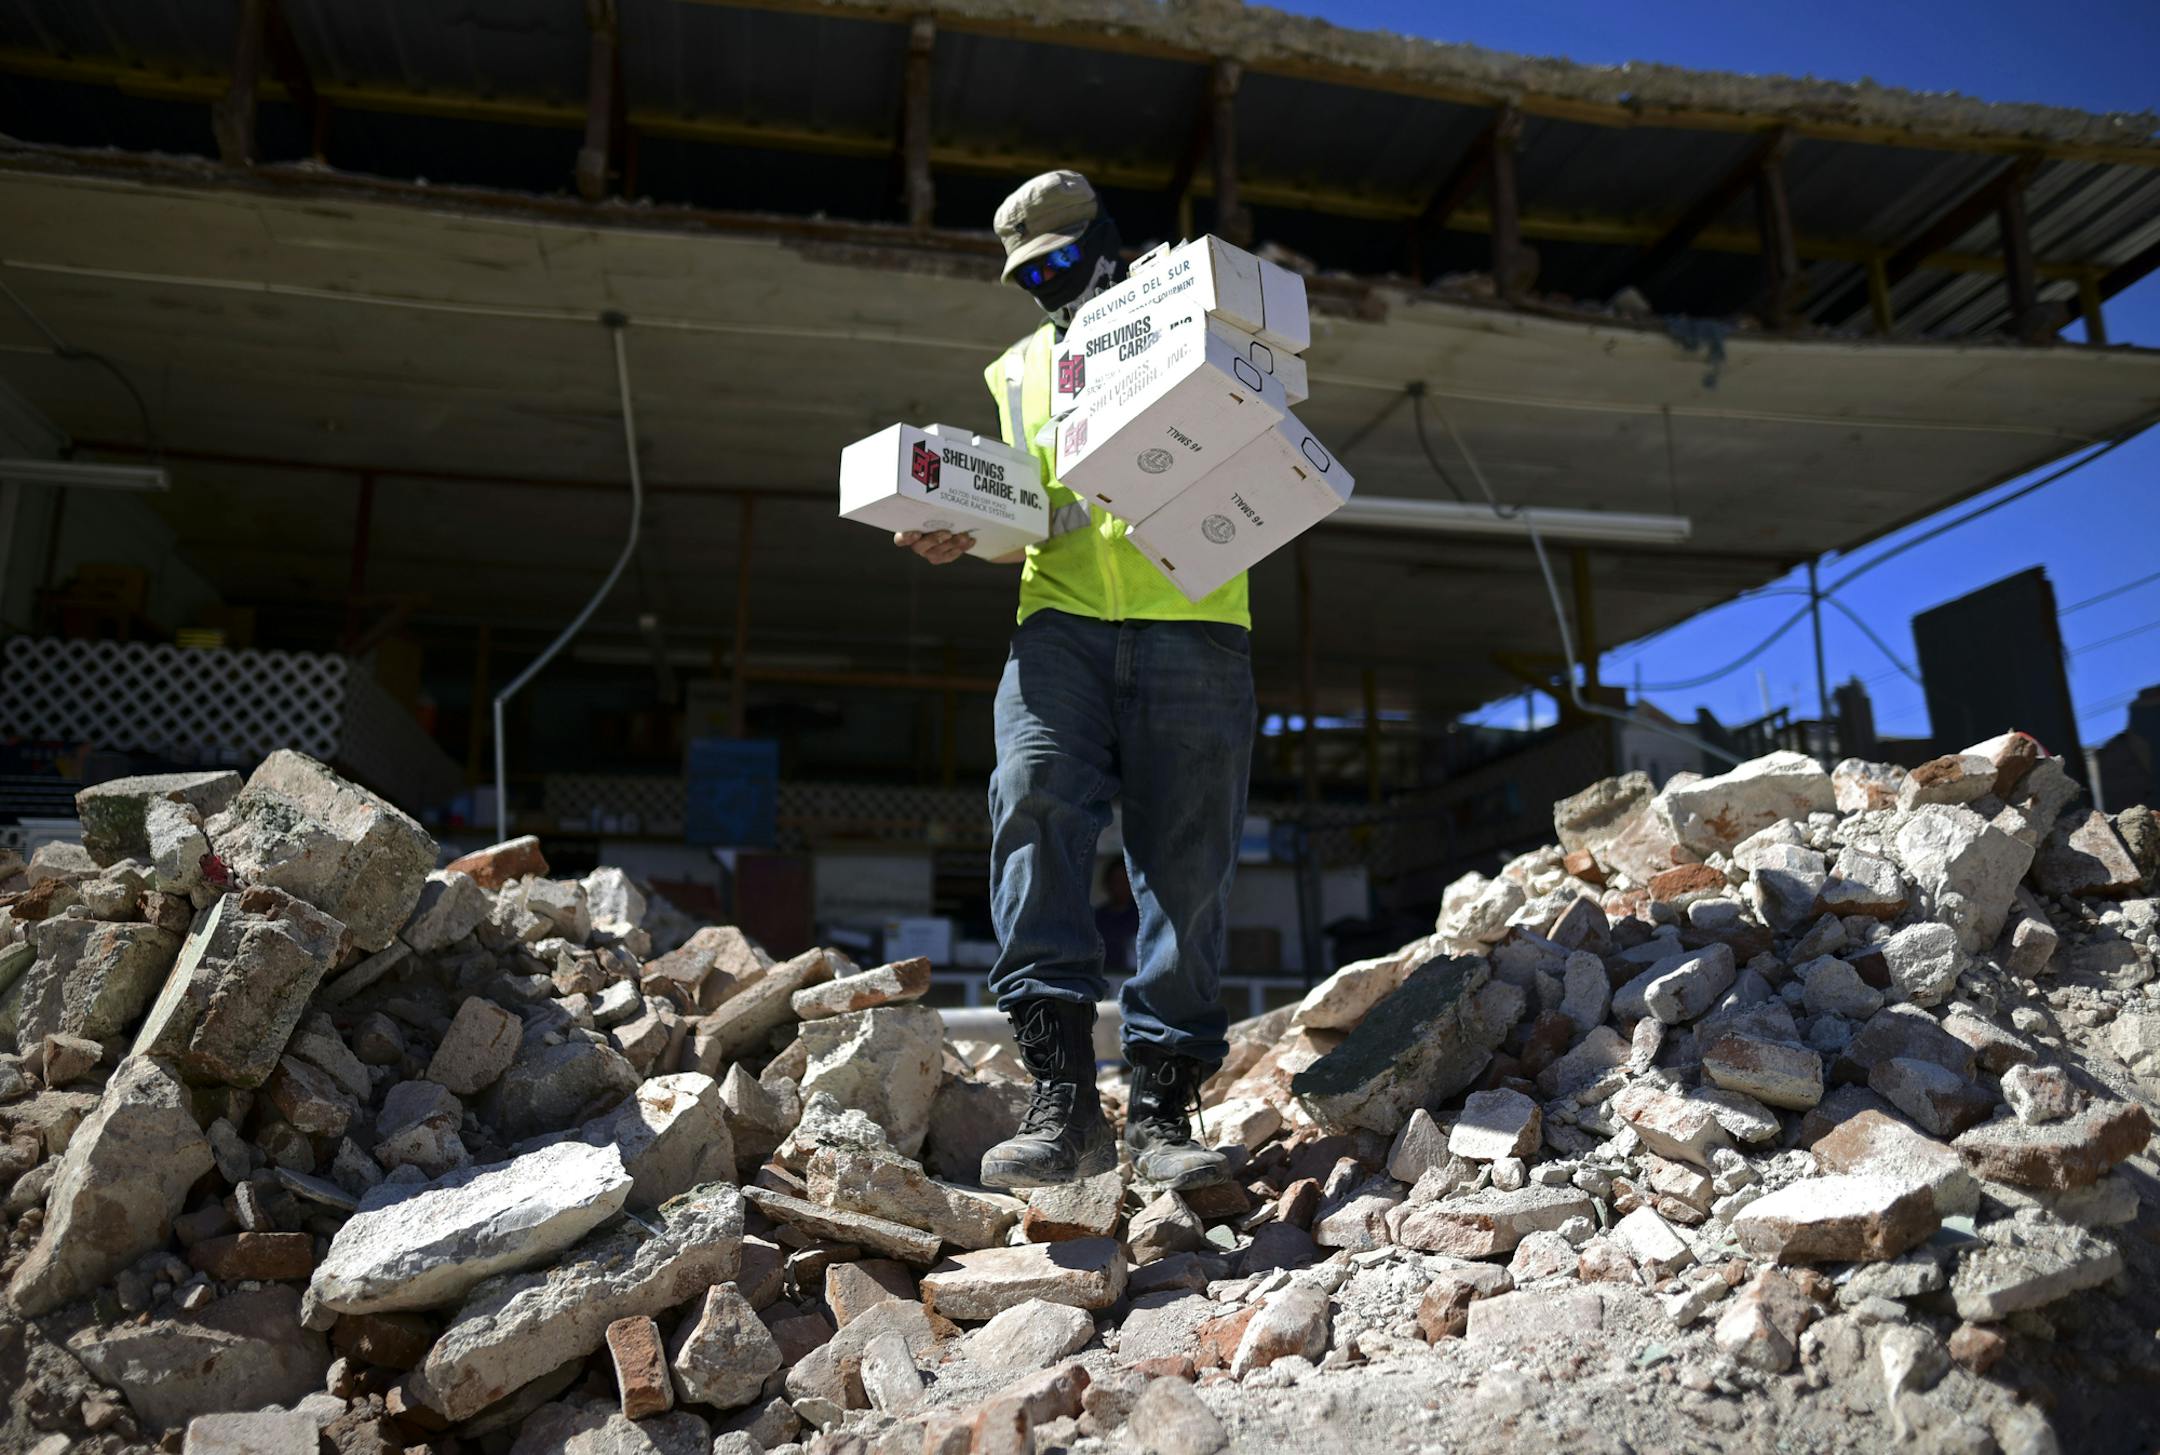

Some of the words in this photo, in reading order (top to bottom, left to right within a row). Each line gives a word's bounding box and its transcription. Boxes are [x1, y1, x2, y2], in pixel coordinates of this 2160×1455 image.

[1082, 290, 1137, 328] SHELVING
[1142, 276, 1162, 295] DEL
[1167, 259, 1191, 281] SUR
[1085, 315, 1151, 358] SHELVINGS
[1165, 425, 1192, 447] SMALL
[942, 447, 1005, 481] SHELVINGS
[973, 474, 1017, 505] CARIBE,
[1020, 488, 1043, 510] INC.
[1230, 492, 1255, 517] SMALL
